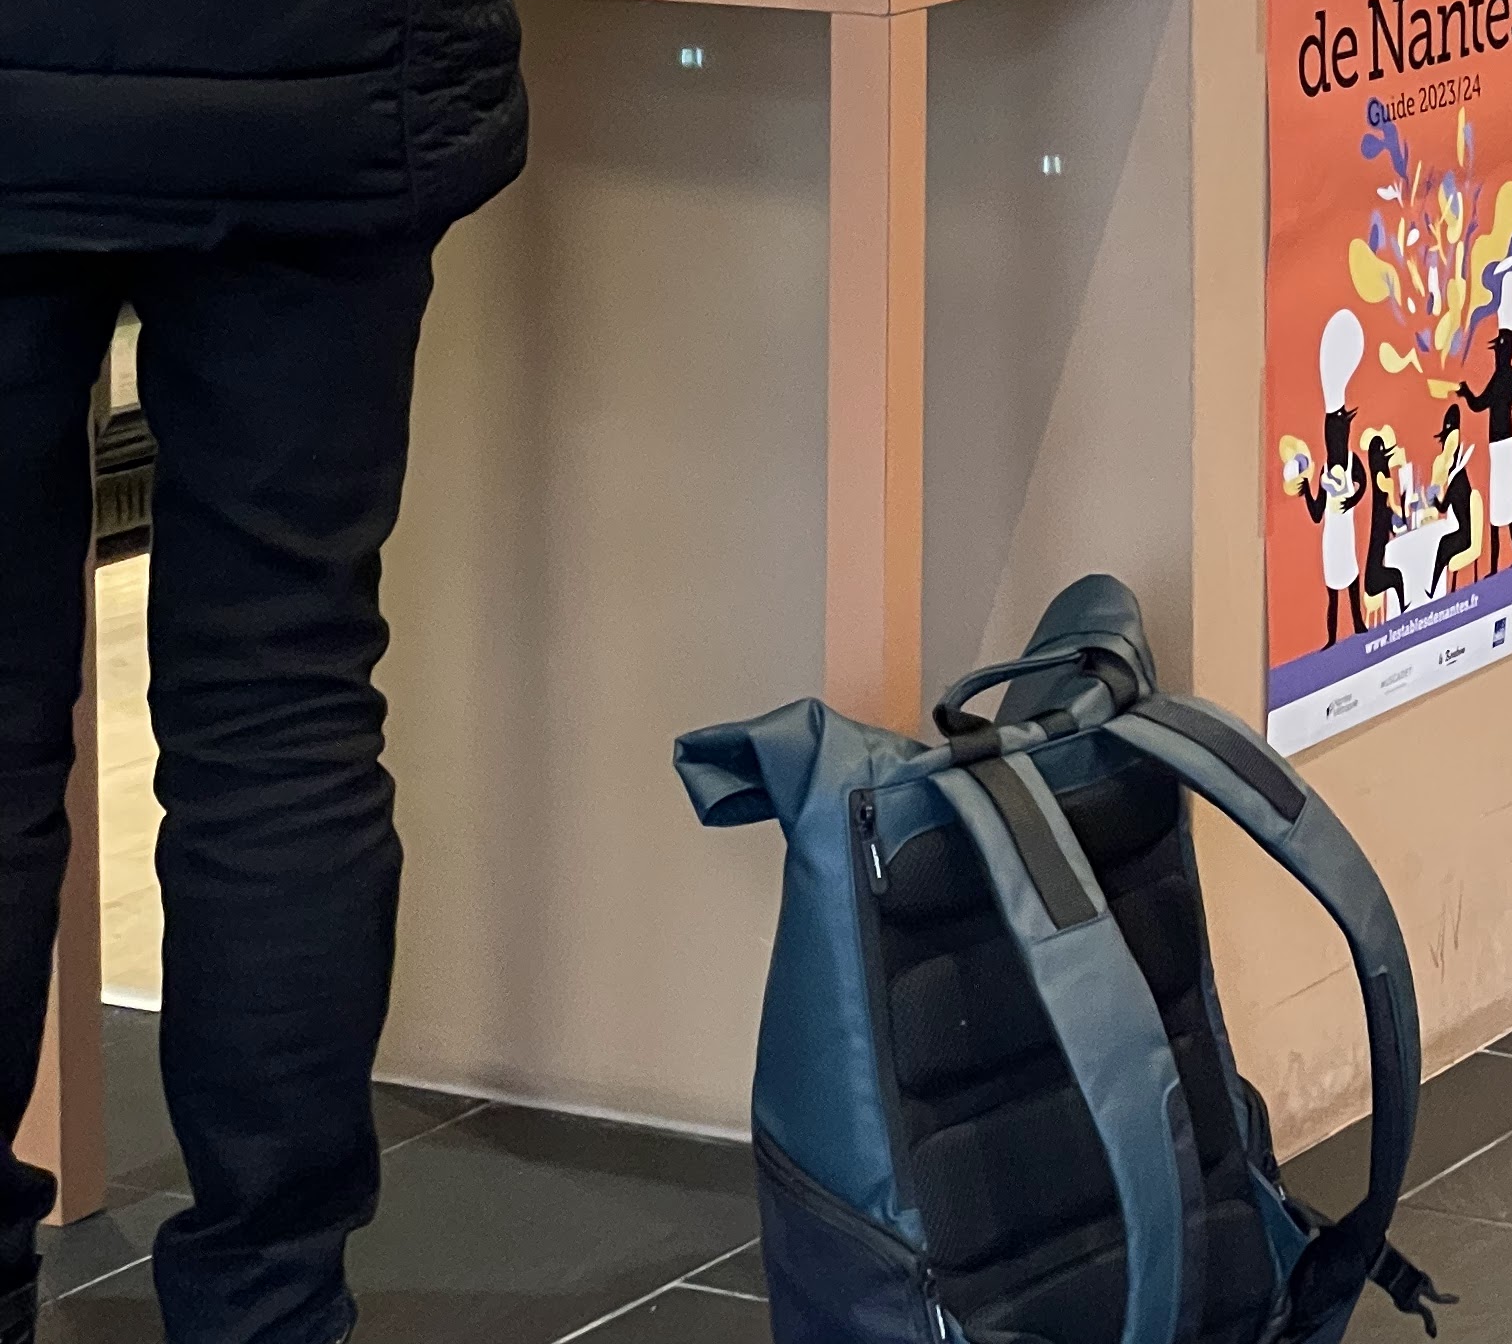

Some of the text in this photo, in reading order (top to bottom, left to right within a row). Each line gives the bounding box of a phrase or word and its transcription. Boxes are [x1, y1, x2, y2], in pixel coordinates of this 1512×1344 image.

[1299, 10, 1360, 98] de
[1367, 74, 1482, 127] Guide 2023/24
[1364, 593, 1479, 654] www.lestablesdenantes.fr
